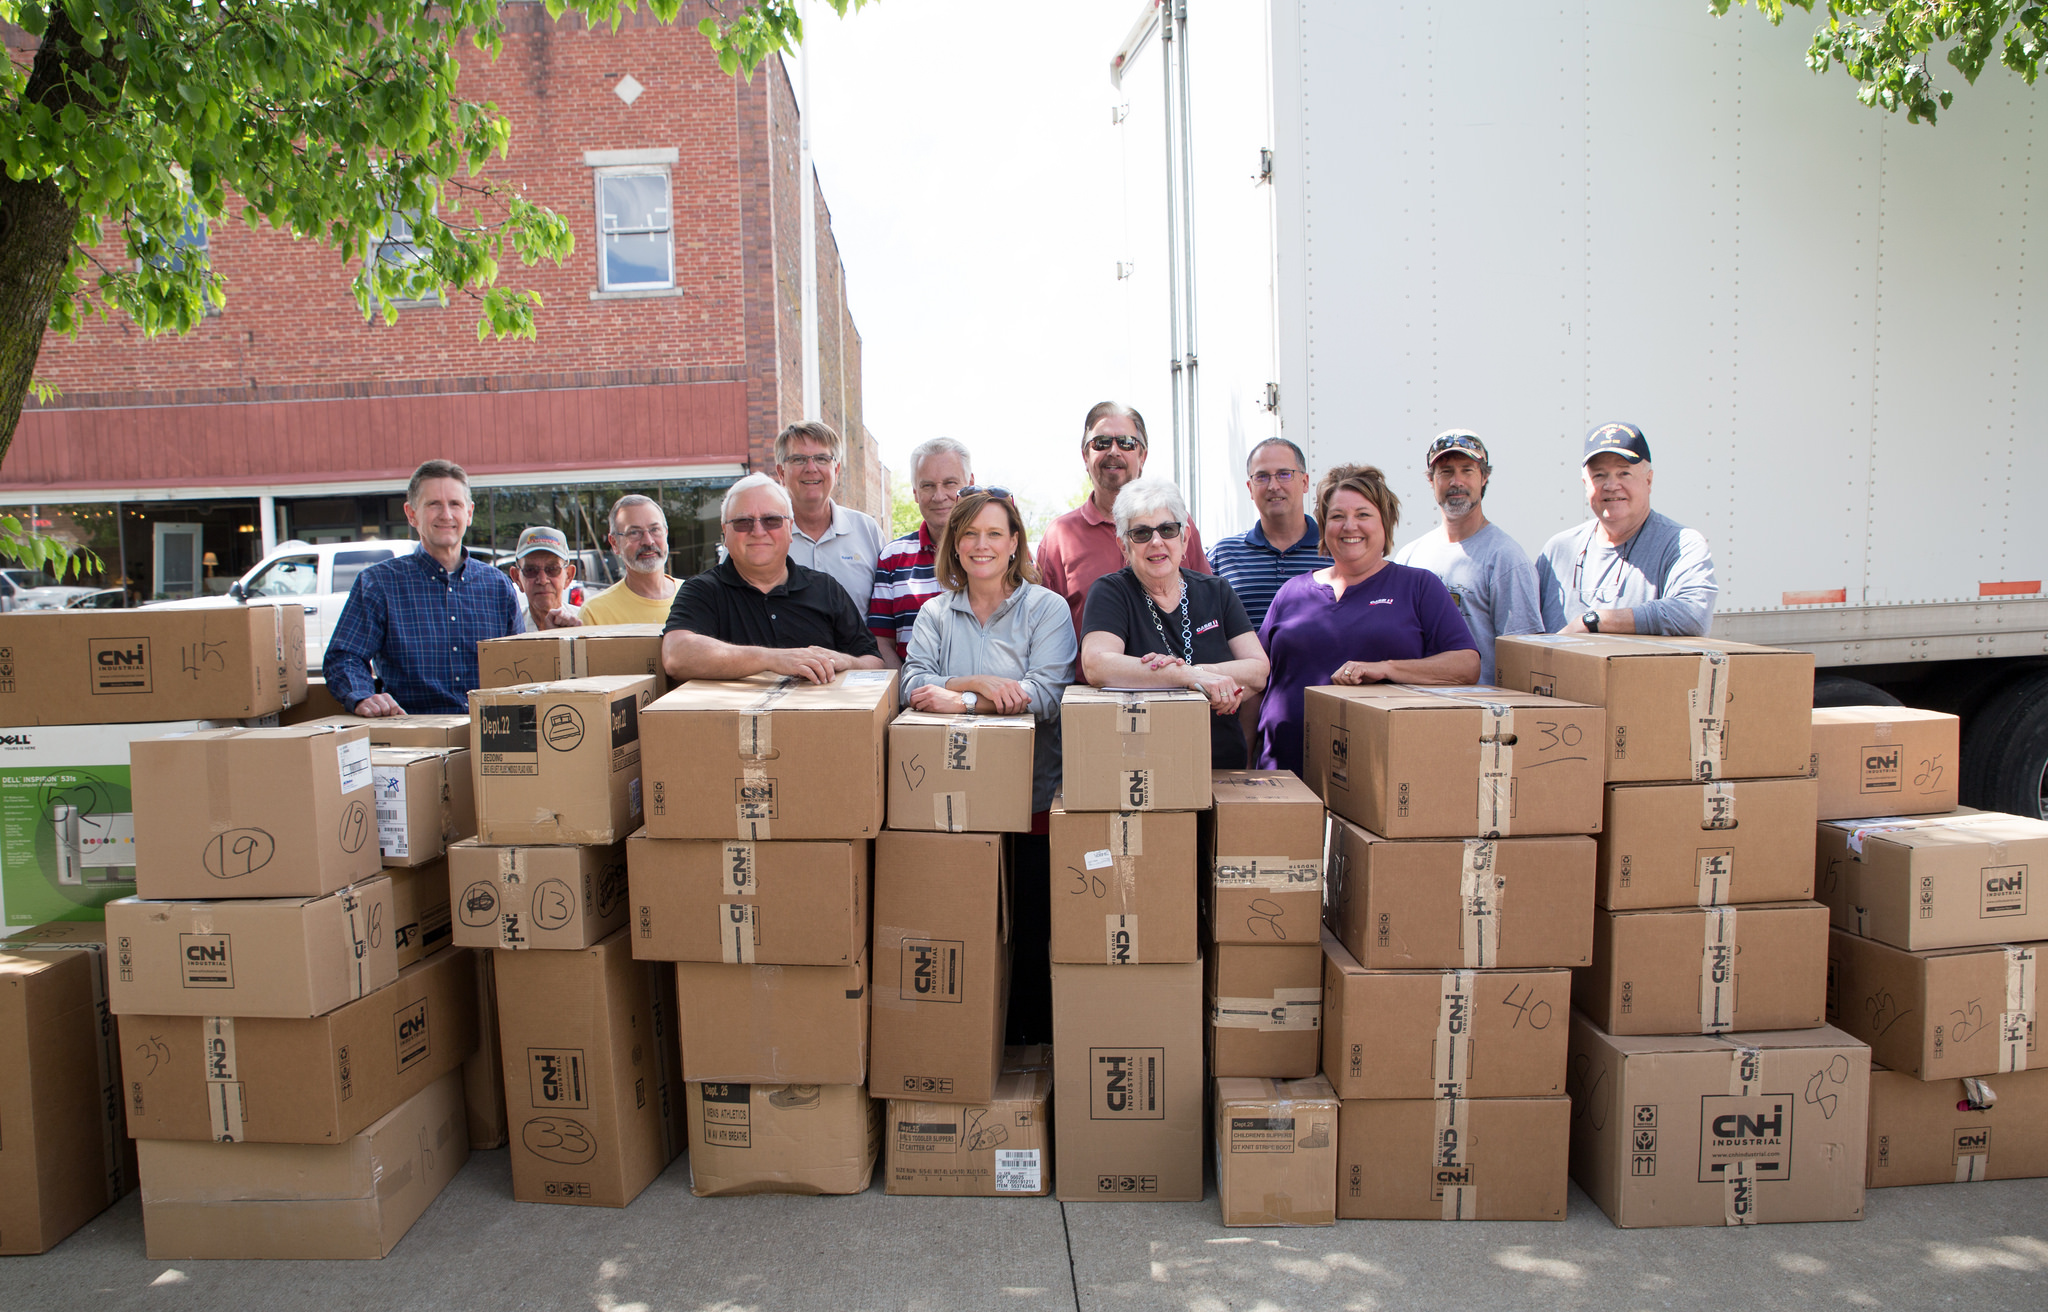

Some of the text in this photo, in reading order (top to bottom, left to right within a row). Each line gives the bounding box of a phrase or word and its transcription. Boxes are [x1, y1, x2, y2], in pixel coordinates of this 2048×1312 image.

[182, 640, 228, 680] 45
[482, 715, 511, 740] Dept.22
[1536, 720, 1583, 752] 30
[483, 753, 504, 762] BEDDING
[901, 754, 926, 791] 15
[1913, 753, 1944, 789] 25
[47, 785, 101, 828] 52
[343, 803, 364, 849] 19
[219, 834, 258, 876] 19
[1067, 866, 1106, 898] 30
[540, 886, 568, 921] 13
[366, 902, 382, 949] 18
[1502, 983, 1552, 1030] 40
[1949, 997, 1983, 1042] 25
[529, 1121, 589, 1153] 33
